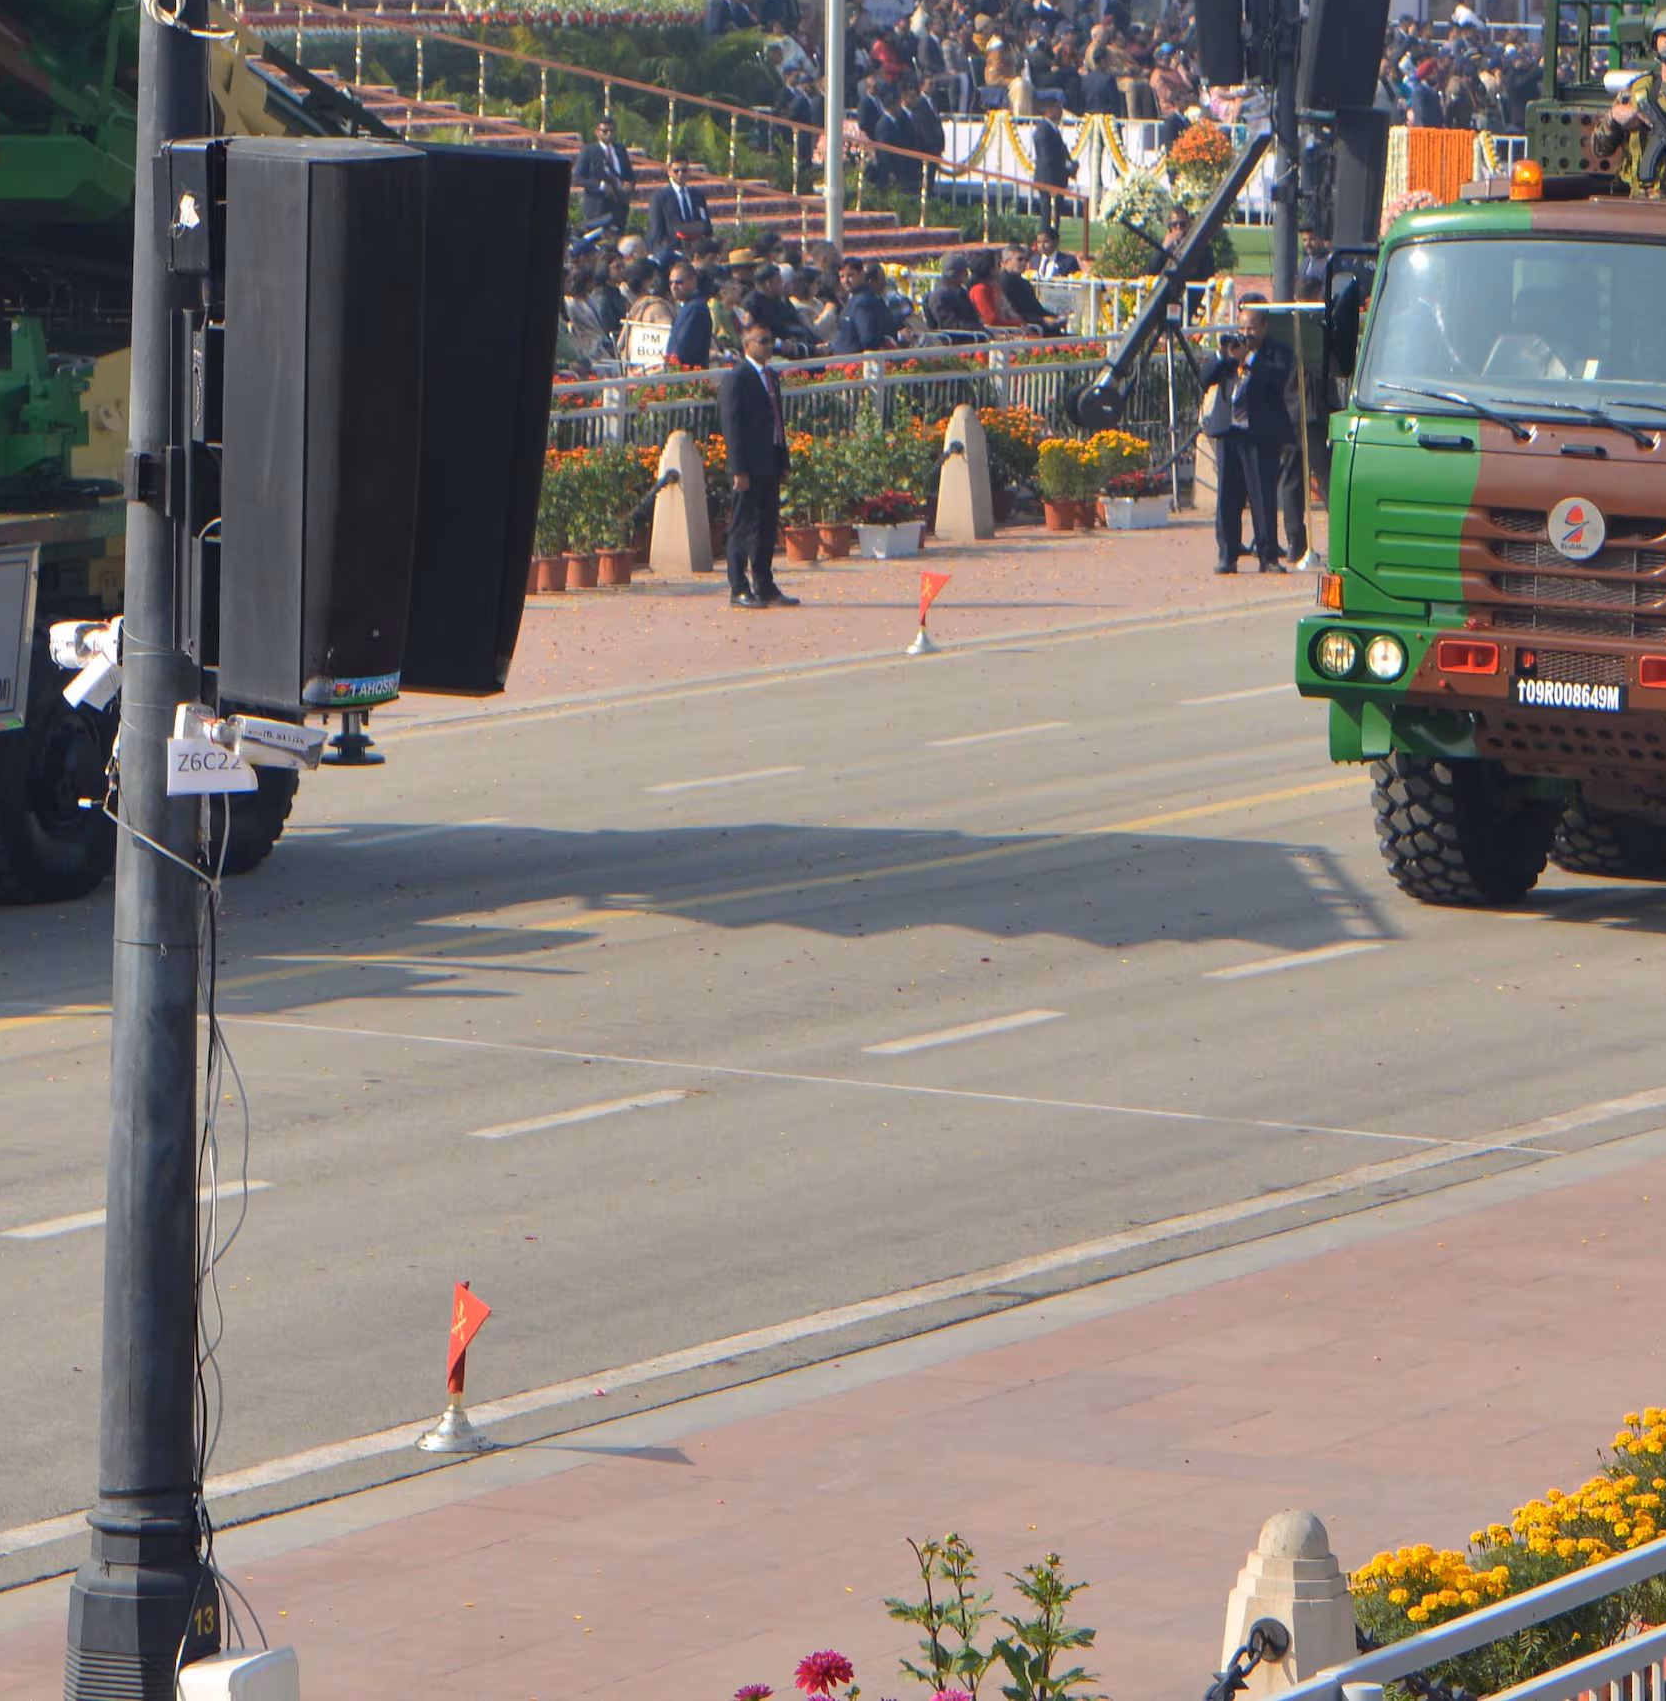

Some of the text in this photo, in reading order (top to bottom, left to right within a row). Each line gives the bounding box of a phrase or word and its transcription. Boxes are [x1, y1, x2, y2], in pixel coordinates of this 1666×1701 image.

[642, 333, 661, 343] PM
[637, 345, 664, 356] BOX
[177, 753, 243, 773] Z6C22
[195, 1605, 214, 1636] 13
